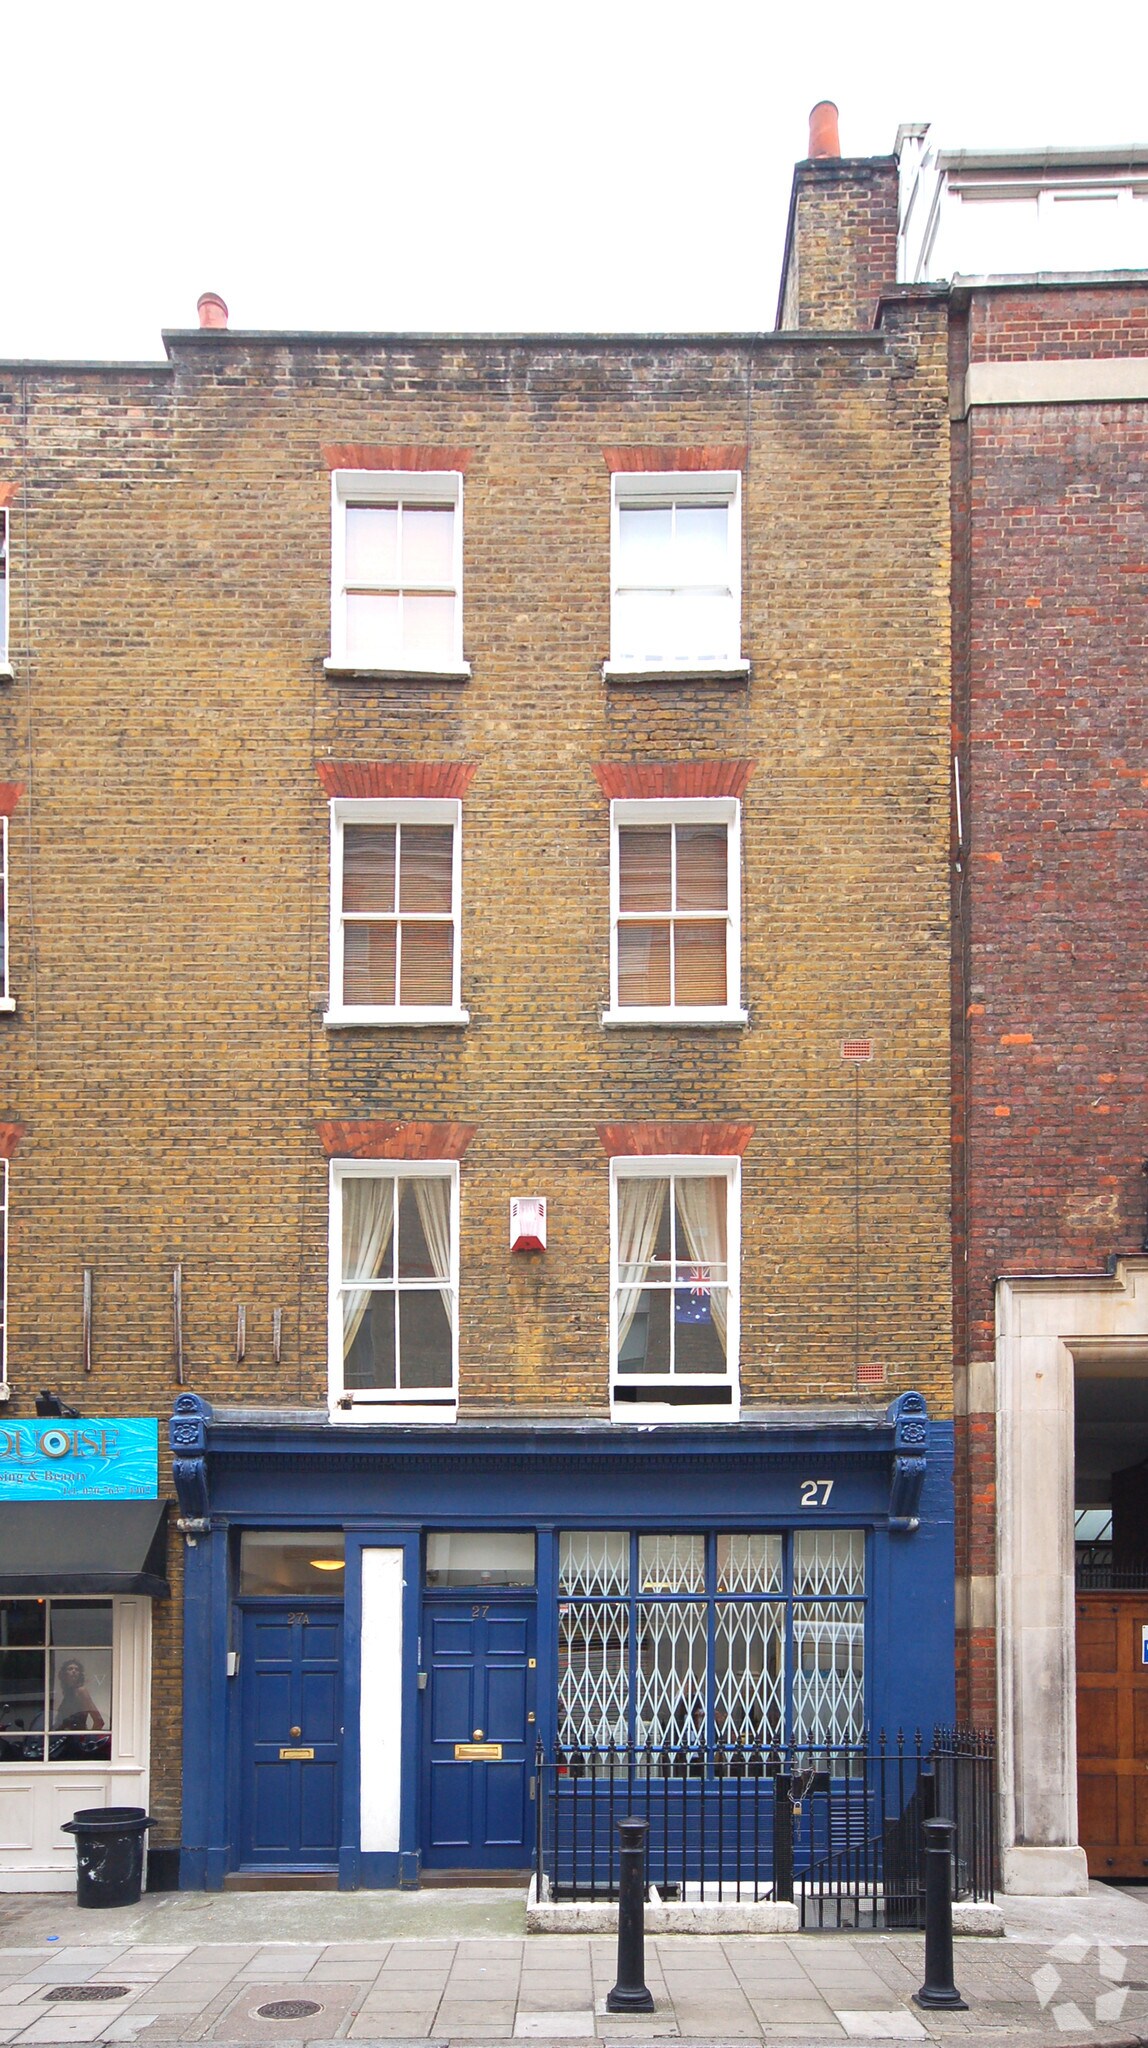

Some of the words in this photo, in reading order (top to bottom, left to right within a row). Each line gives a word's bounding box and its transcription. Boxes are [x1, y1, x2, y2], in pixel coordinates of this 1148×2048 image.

[28, 1471, 38, 1481] &
[45, 1470, 87, 1484] Beauty
[800, 1480, 834, 1506] 27
[287, 1612, 310, 1624] 27A
[472, 1605, 489, 1618] 27
